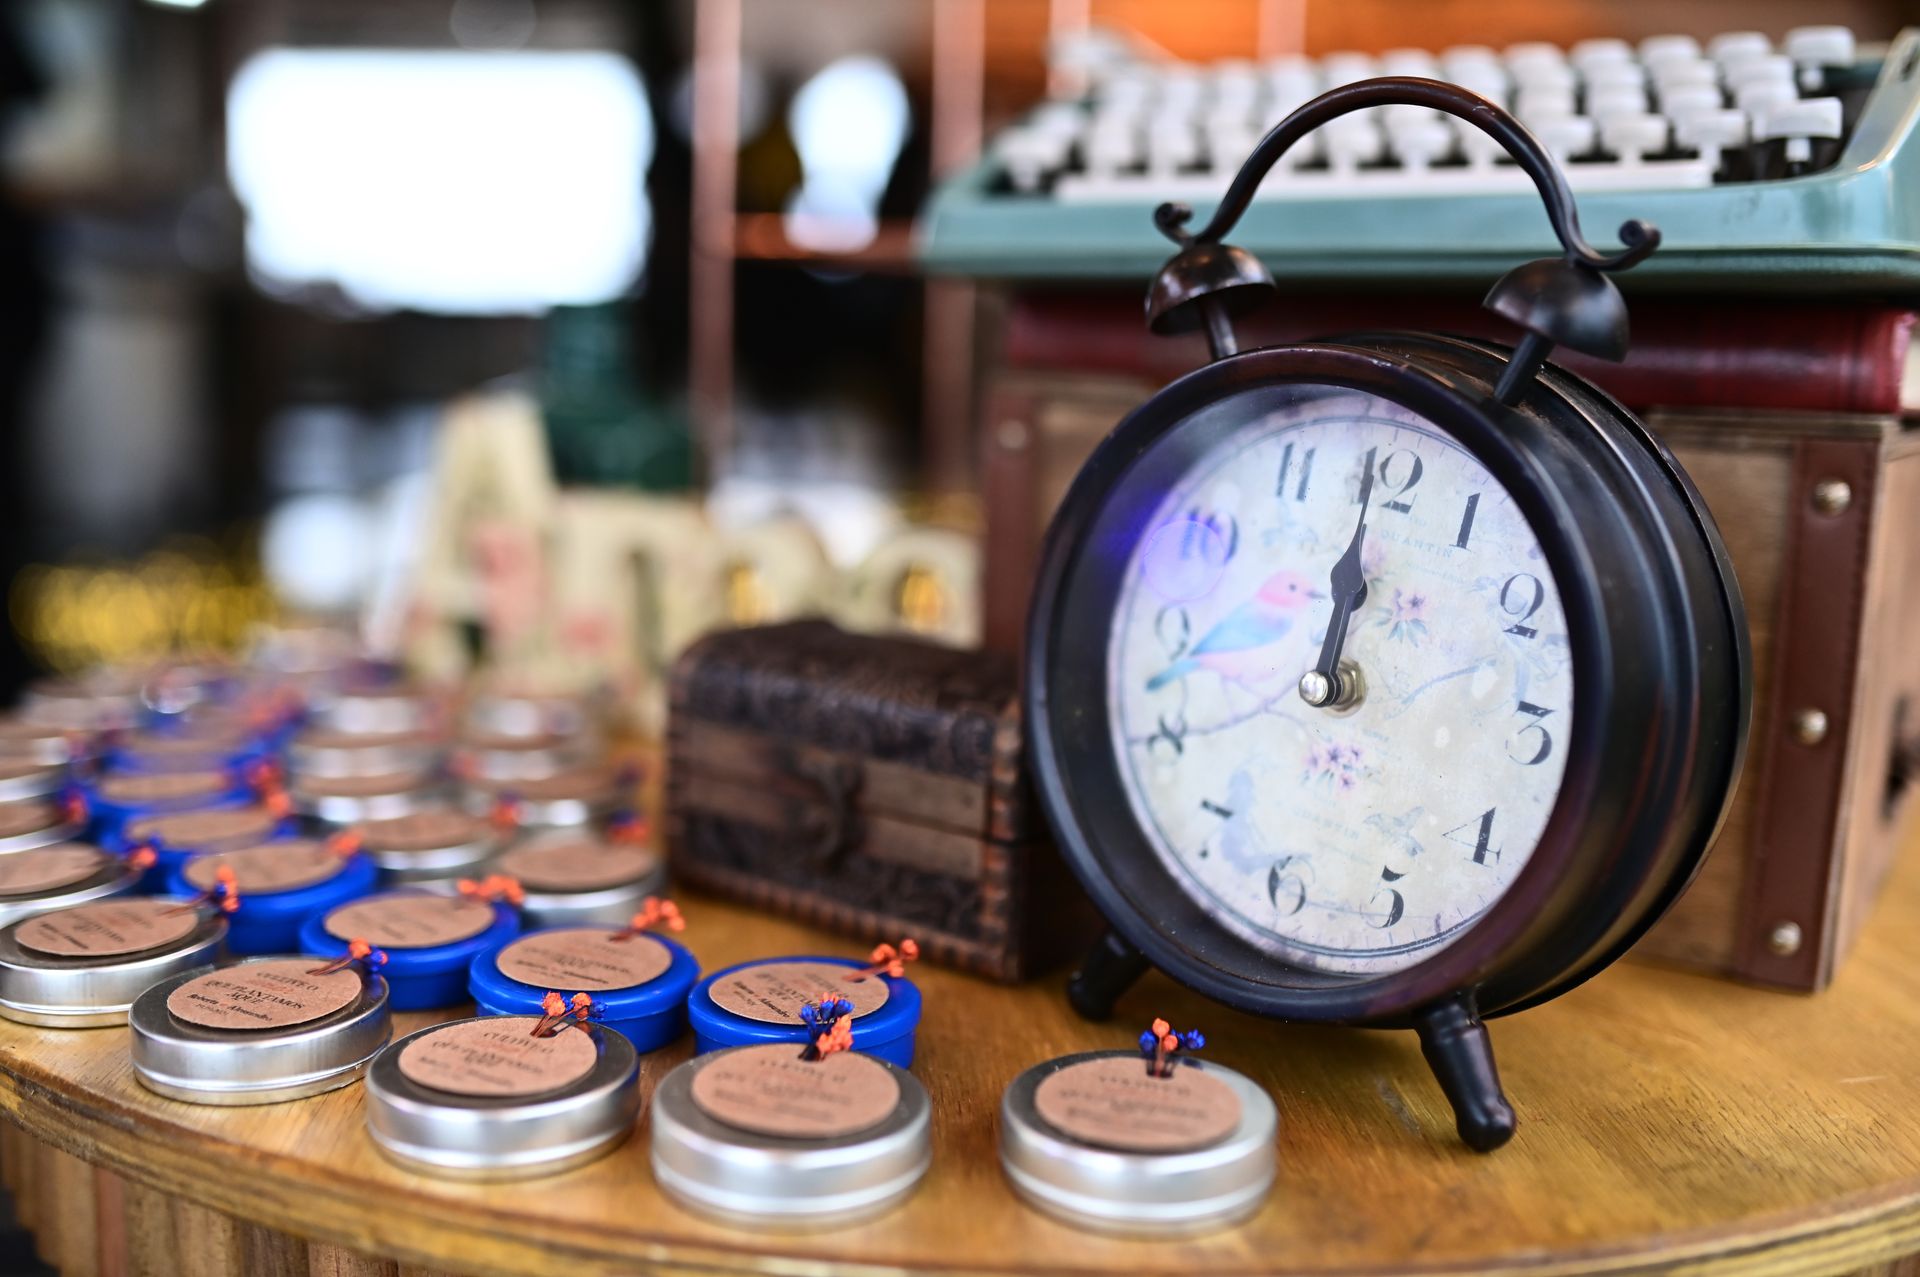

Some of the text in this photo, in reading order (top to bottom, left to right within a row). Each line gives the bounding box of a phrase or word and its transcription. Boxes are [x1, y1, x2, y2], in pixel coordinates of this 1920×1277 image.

[1276, 442, 1316, 502] 11
[1351, 446, 1423, 514] 12
[1449, 492, 1481, 550] 1
[1500, 573, 1544, 639] 2
[1505, 700, 1555, 766] 3
[1440, 807, 1503, 868] 4
[1267, 855, 1316, 917] 6
[1360, 865, 1407, 929] 5
